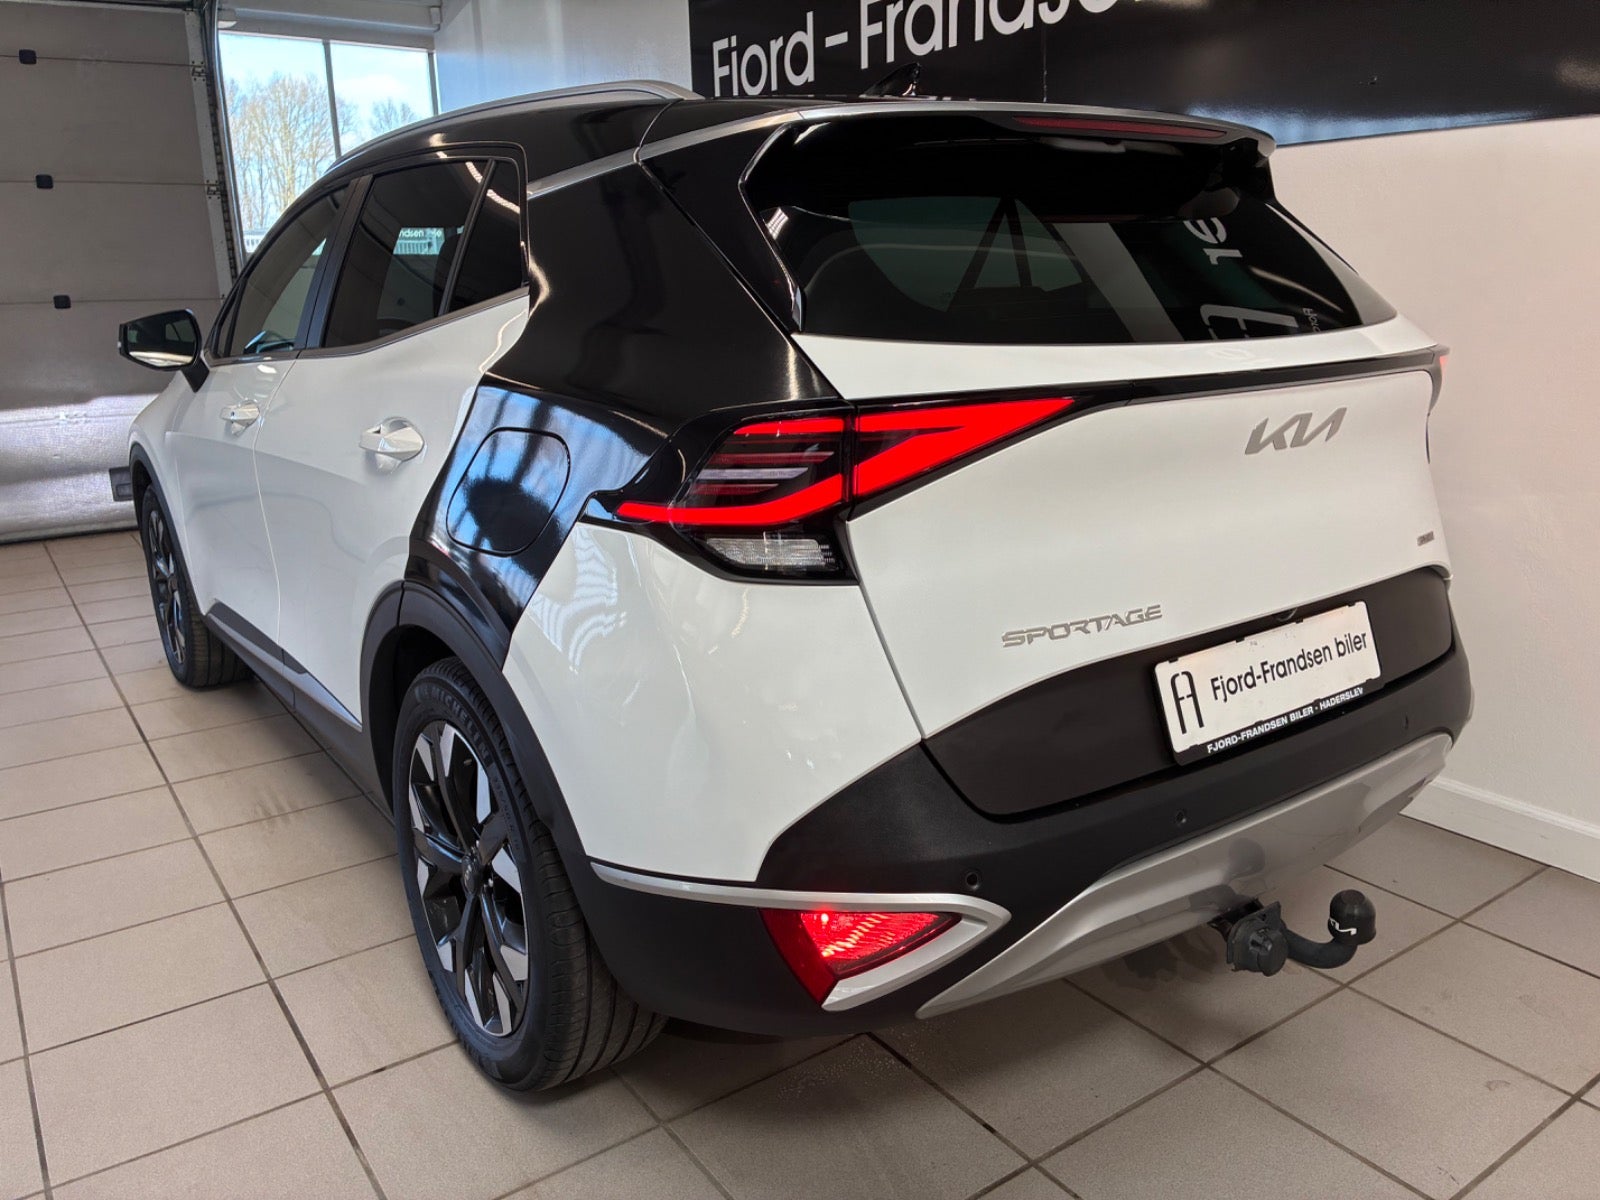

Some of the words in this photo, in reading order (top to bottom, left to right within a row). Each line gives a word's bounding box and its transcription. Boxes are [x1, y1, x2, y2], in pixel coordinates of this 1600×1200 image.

[1245, 407, 1347, 455] KIA
[1001, 604, 1163, 648] SPORTAGE
[1210, 645, 1333, 703] Fjord-Frandsen
[1334, 631, 1368, 658] biler
[1207, 717, 1288, 754] FJORD-FRANDSEN
[1289, 706, 1314, 721] BILER
[1319, 687, 1364, 711] HADERSLEV
